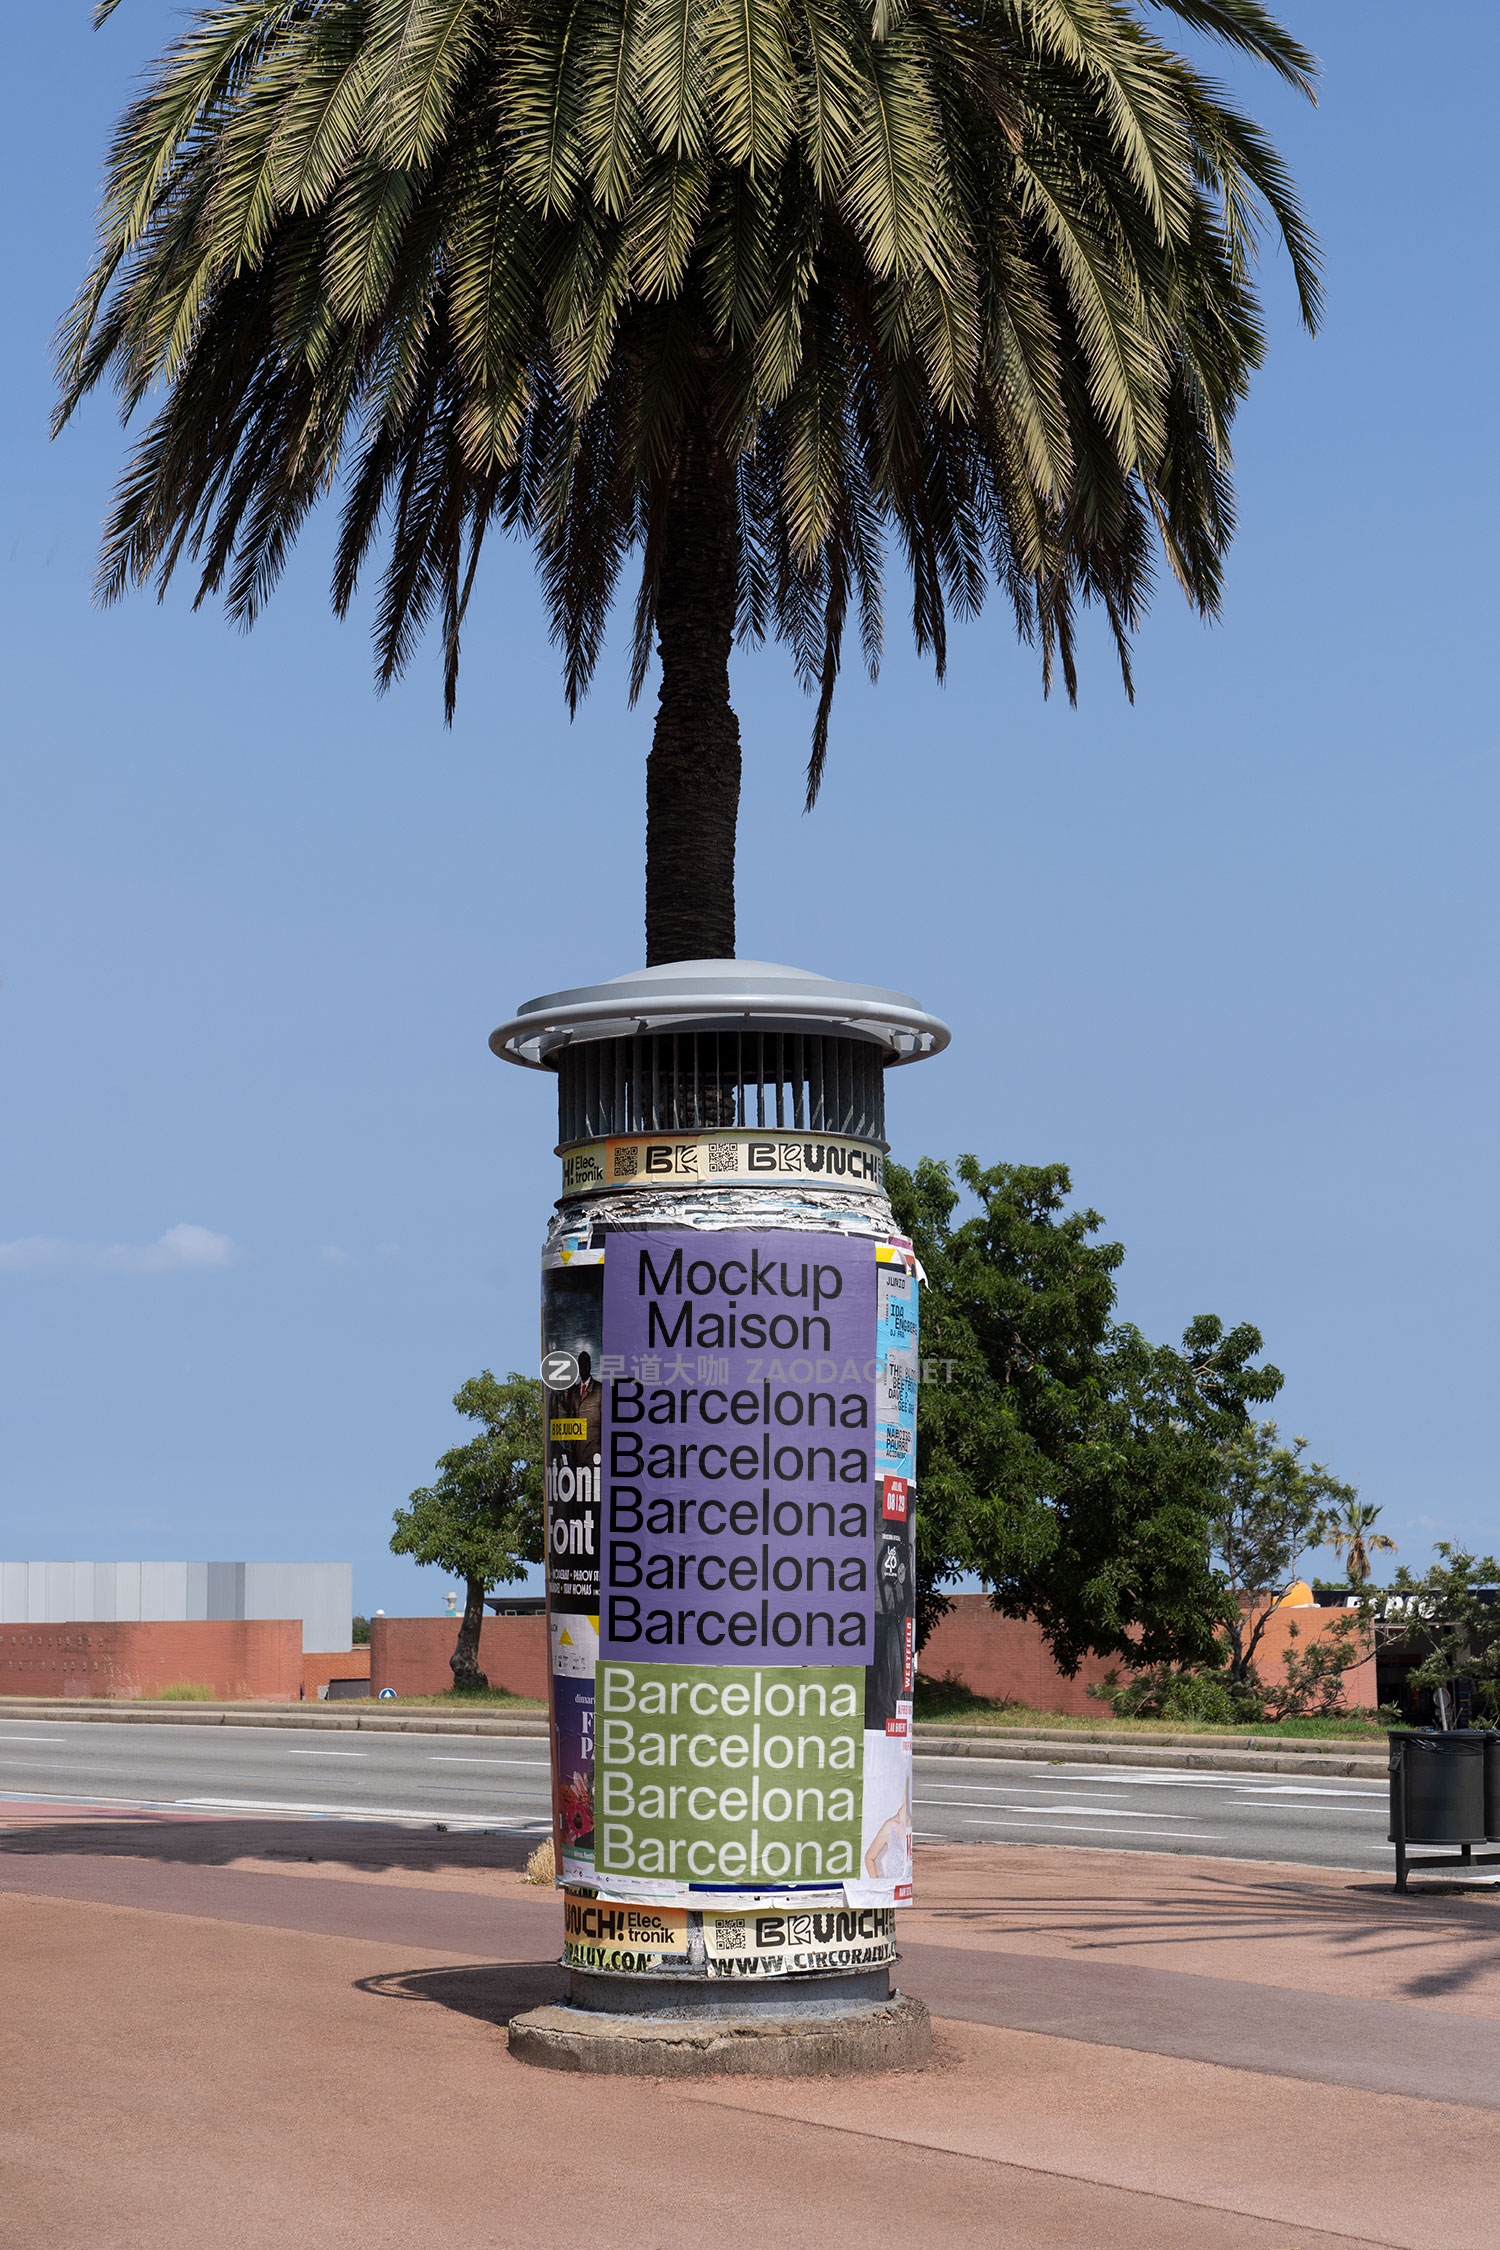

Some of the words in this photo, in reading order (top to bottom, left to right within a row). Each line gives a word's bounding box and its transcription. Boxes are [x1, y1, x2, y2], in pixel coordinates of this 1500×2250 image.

[575, 1155, 595, 1170] Elec
[575, 1164, 603, 1184] tronik
[748, 1143, 878, 1184] BRUNCH!
[639, 1248, 843, 1311] Mockup
[648, 1300, 831, 1351] Maison
[610, 1378, 868, 1429] Barcelona
[610, 1431, 867, 1483] Barcelona
[609, 1486, 867, 1537] Barcelona
[609, 1541, 866, 1592] Barcelona
[608, 1595, 866, 1647] Barcelona
[603, 1667, 857, 1717] Barcelona
[603, 1719, 856, 1769] Barcelona
[603, 1771, 855, 1822] Barcelona
[603, 1823, 853, 1876] Barcelona
[627, 1911, 662, 1929] Elec
[628, 1926, 675, 1944] tronik
[756, 1909, 889, 1948] BRUNCH!
